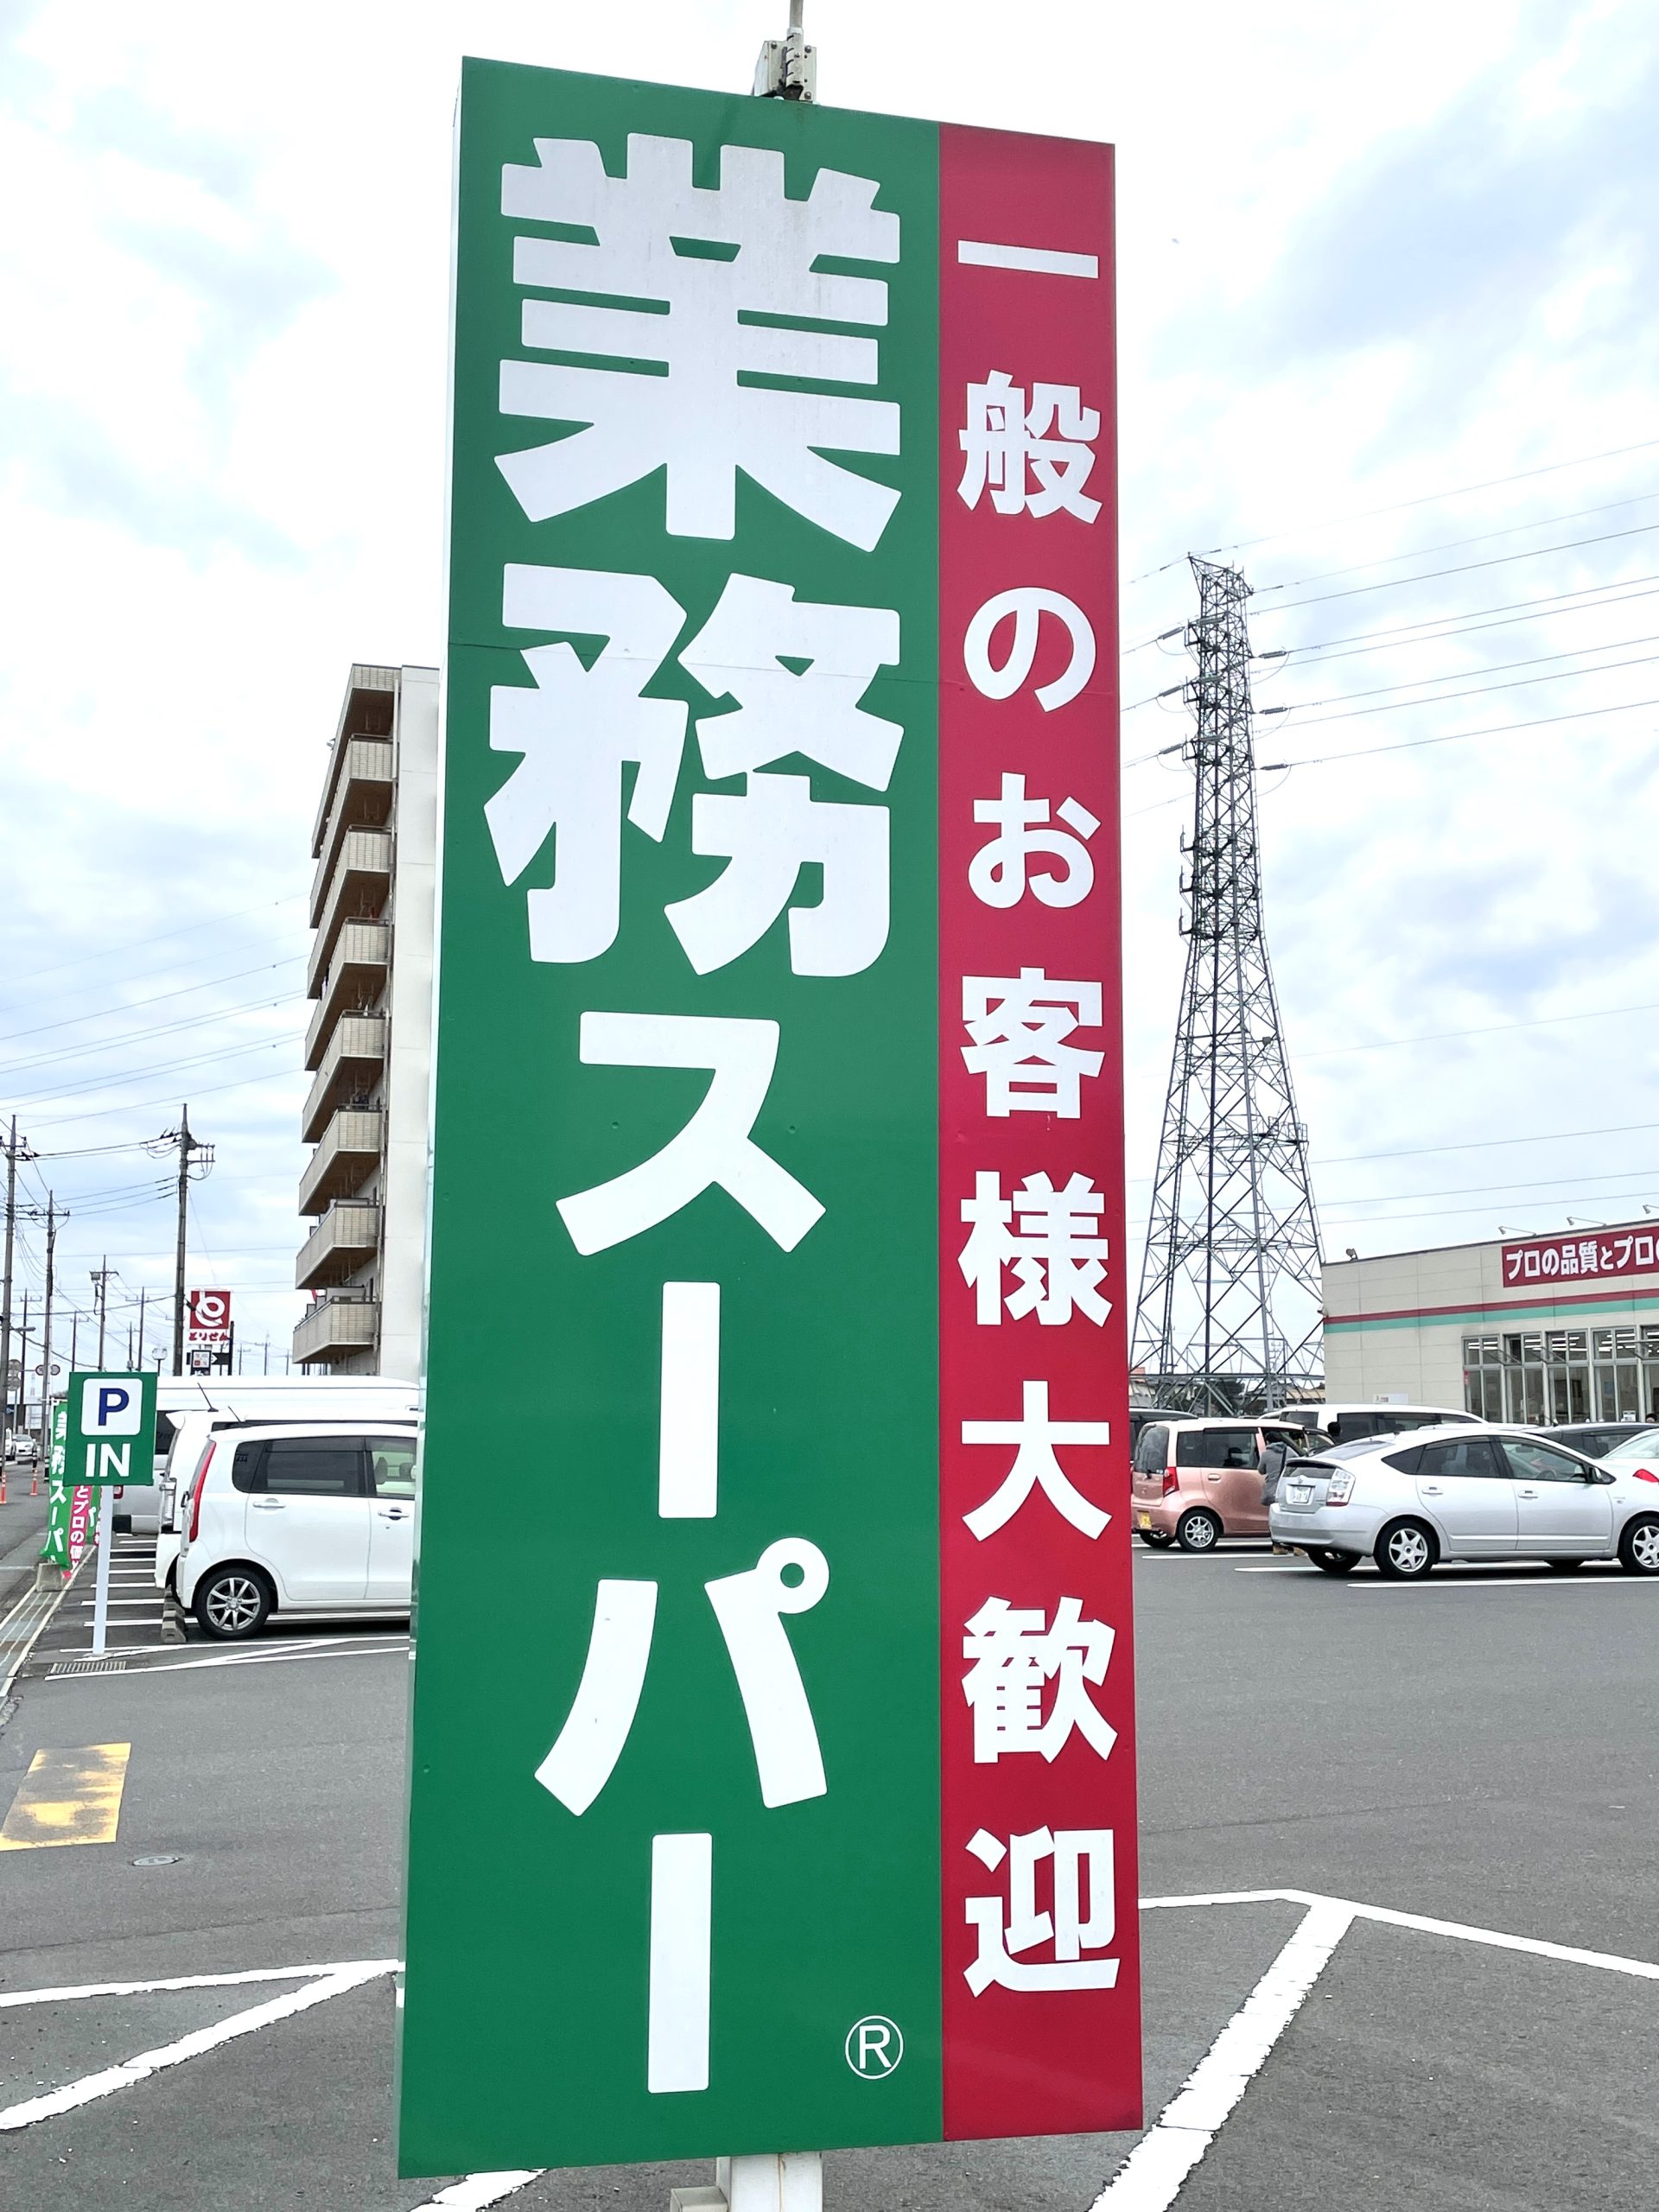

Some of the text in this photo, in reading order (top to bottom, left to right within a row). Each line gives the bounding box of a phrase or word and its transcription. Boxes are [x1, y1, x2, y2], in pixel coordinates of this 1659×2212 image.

[484, 131, 904, 2094] 業務スーパー
[957, 240, 1120, 1998] 一般のお客様大歓迎
[1506, 1235, 1659, 1281] プロの品質とプロ
[98, 1388, 130, 1427] P
[86, 1443, 131, 1478] IN
